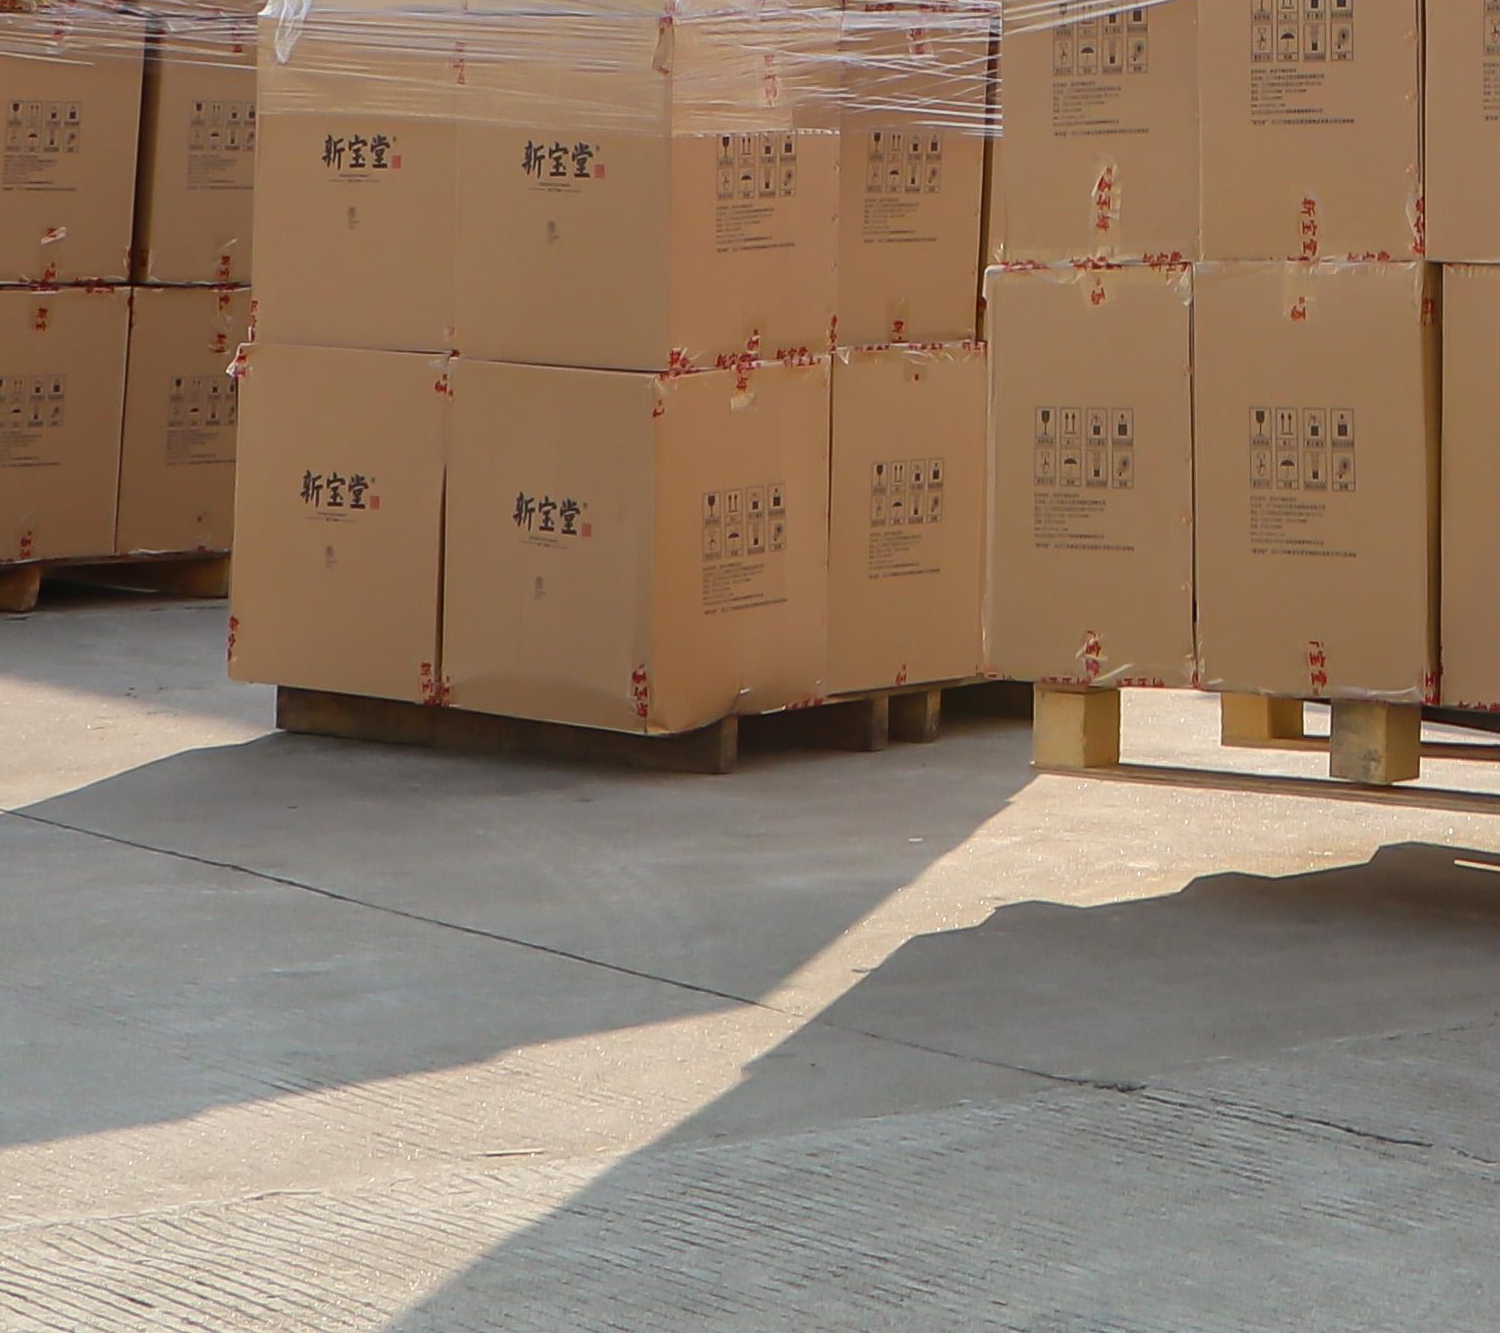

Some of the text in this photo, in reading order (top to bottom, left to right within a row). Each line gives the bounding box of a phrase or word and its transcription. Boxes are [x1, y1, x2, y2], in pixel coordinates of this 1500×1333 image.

[322, 135, 391, 170] 新宝堂
[521, 141, 593, 179] 新宝堂
[300, 470, 370, 510] 新宝堂
[513, 492, 582, 535] 新宝堂
